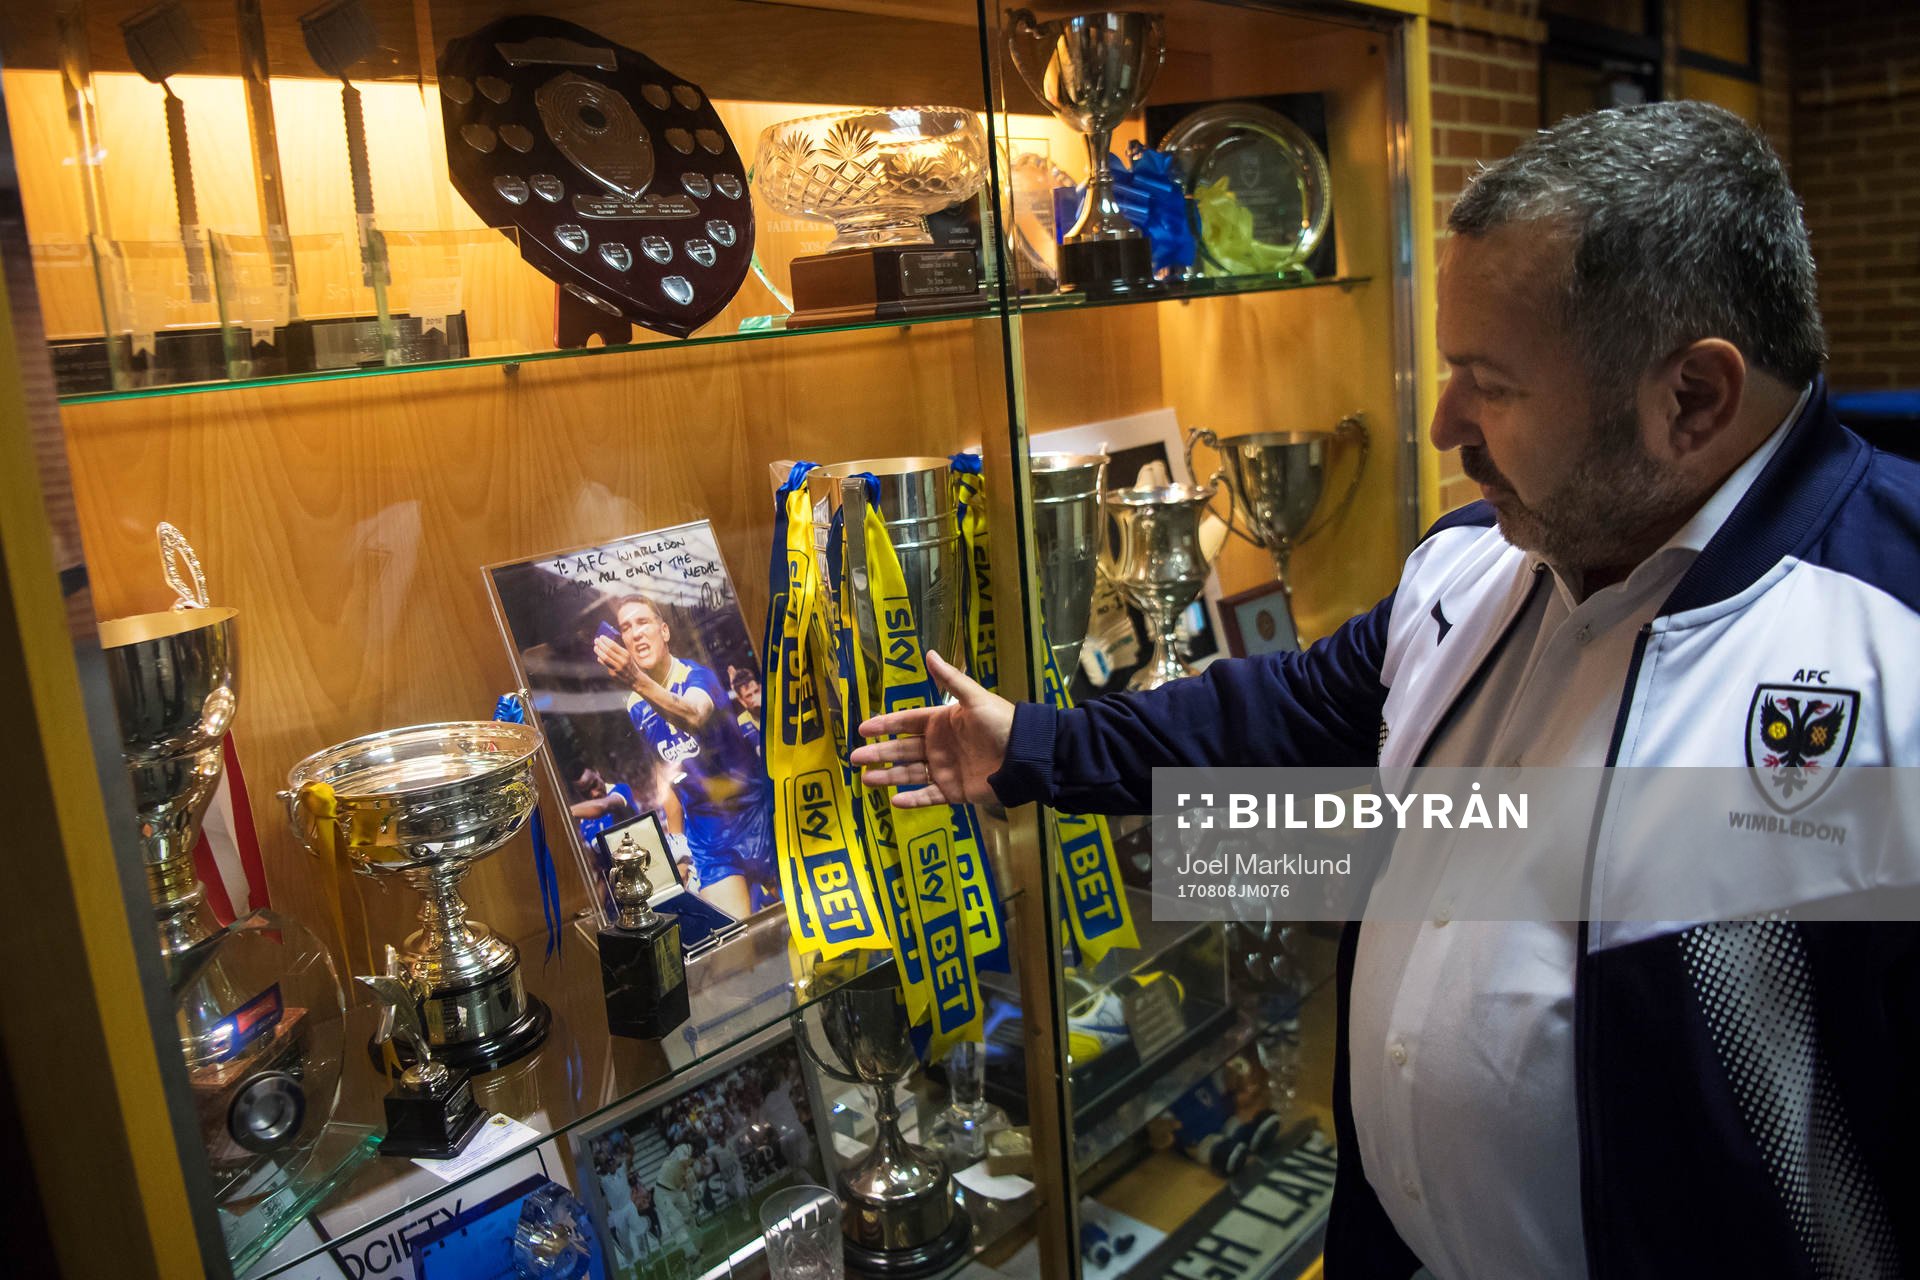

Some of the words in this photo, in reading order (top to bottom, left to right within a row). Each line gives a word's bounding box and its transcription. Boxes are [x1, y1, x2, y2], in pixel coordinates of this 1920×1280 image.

[576, 552, 608, 573] AFC
[617, 537, 686, 561] WIMBLEDON
[626, 561, 662, 577] ENJOY
[669, 553, 692, 569] THE
[683, 562, 719, 579] MEDAL
[885, 608, 917, 673] sky
[1792, 668, 1831, 684] AFC
[801, 782, 833, 842] sky
[1728, 811, 1847, 846] WIMBLEDON
[813, 861, 866, 932] BET
[919, 842, 947, 904] sky
[1070, 844, 1115, 920] BET
[930, 925, 969, 1012] BET
